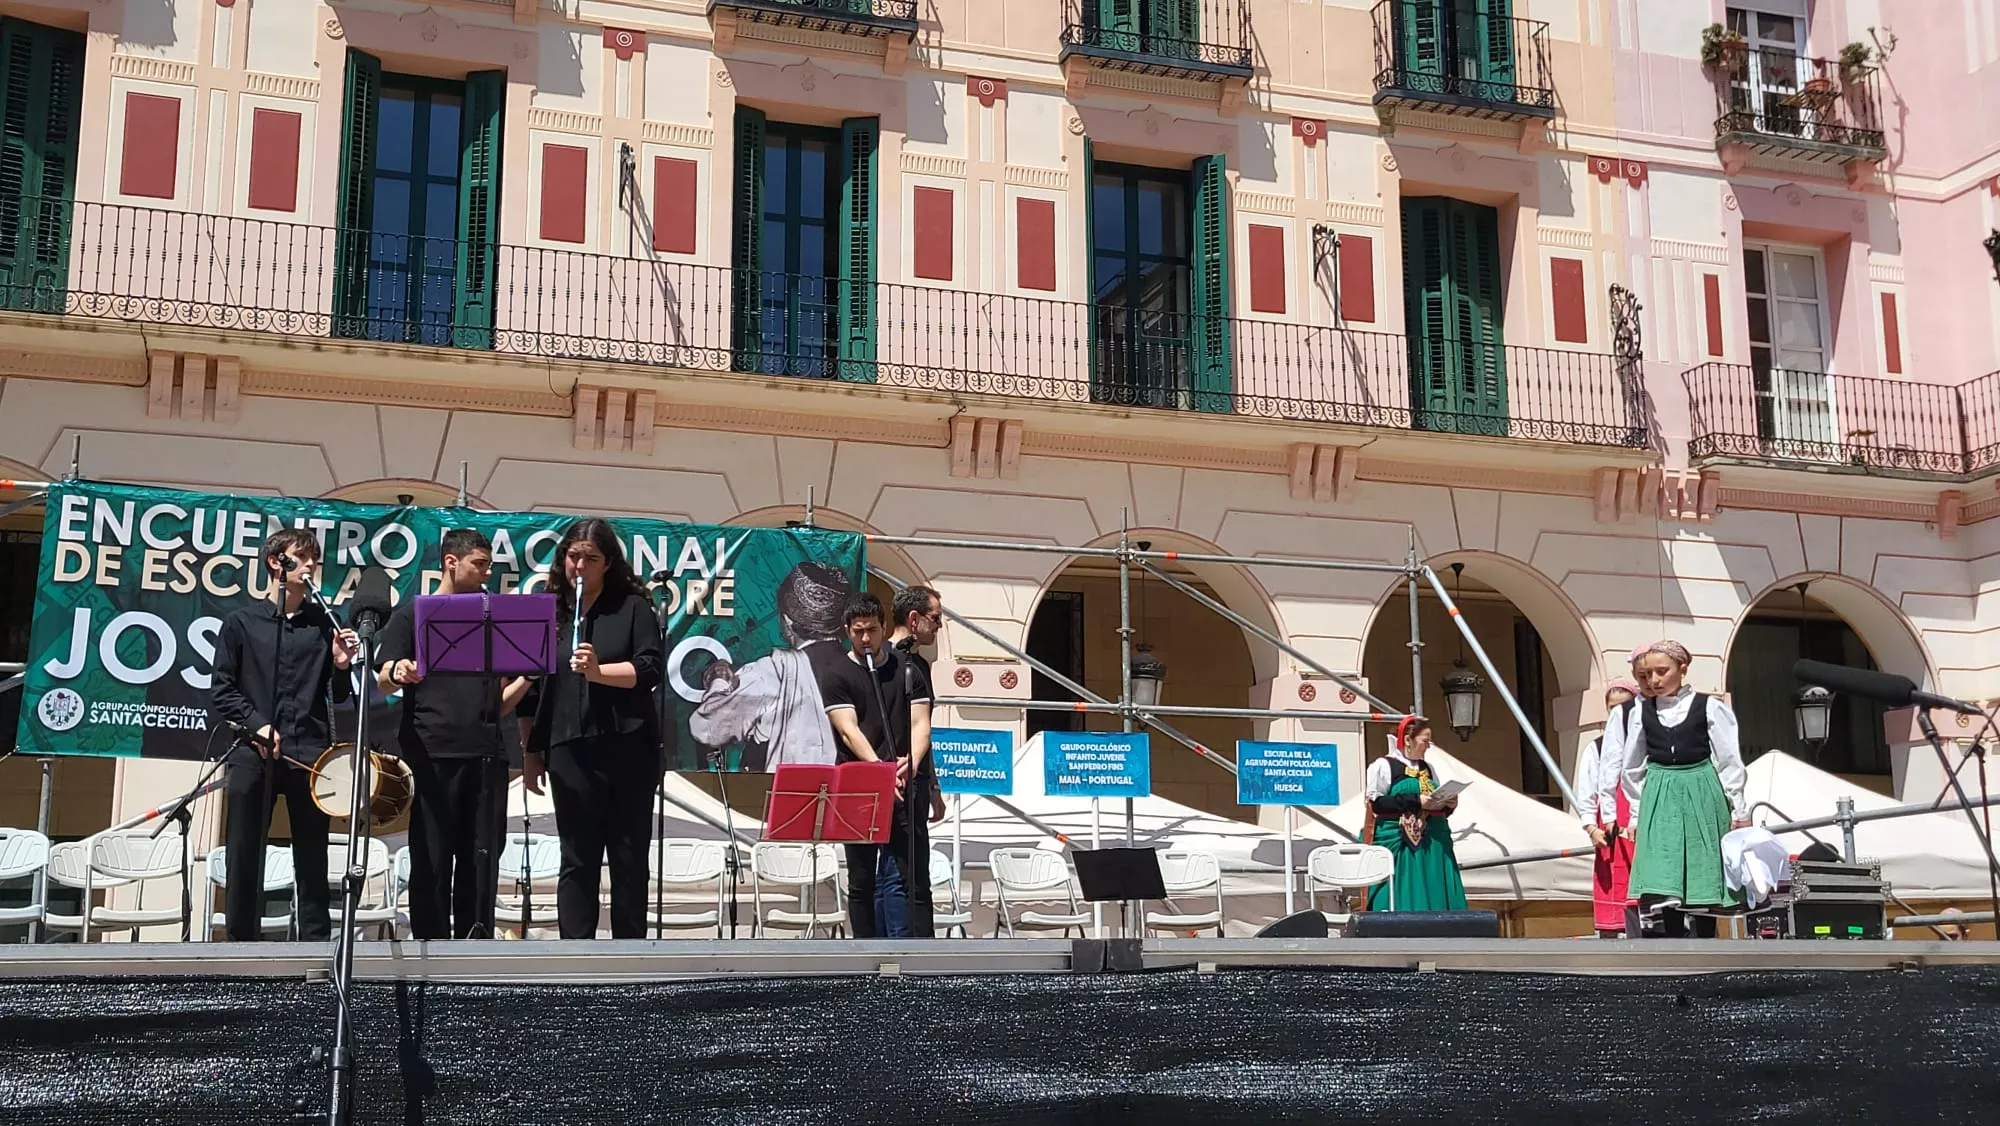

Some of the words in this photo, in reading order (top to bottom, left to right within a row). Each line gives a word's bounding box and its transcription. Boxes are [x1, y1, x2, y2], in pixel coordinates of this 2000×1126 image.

[52, 541, 120, 586] DE
[140, 548, 400, 608] ESCULA
[961, 742, 998, 754] DANTZA
[1060, 743, 1085, 752] GRUPO
[1086, 742, 1131, 752] FOLCLÓRICO
[943, 754, 976, 765] TALDEA
[1097, 753, 1126, 762] JUVENIL
[1263, 750, 1293, 759] ESCUELA
[1294, 750, 1302, 759] DE
[1303, 751, 1312, 759] LA
[1068, 762, 1084, 770] SAN
[1084, 762, 1107, 771] PEDRO
[1245, 758, 1289, 767] AGRUPACIÓN
[1289, 759, 1331, 769] FOLKLÓRICA
[955, 767, 1006, 780] GUIPÚZCOA
[1264, 768, 1286, 777] SANTA
[1287, 769, 1313, 777] CECILIA
[1059, 775, 1081, 785] MAIA
[1088, 775, 1134, 785] PORTUGAL
[1274, 783, 1303, 793] HUESCA
